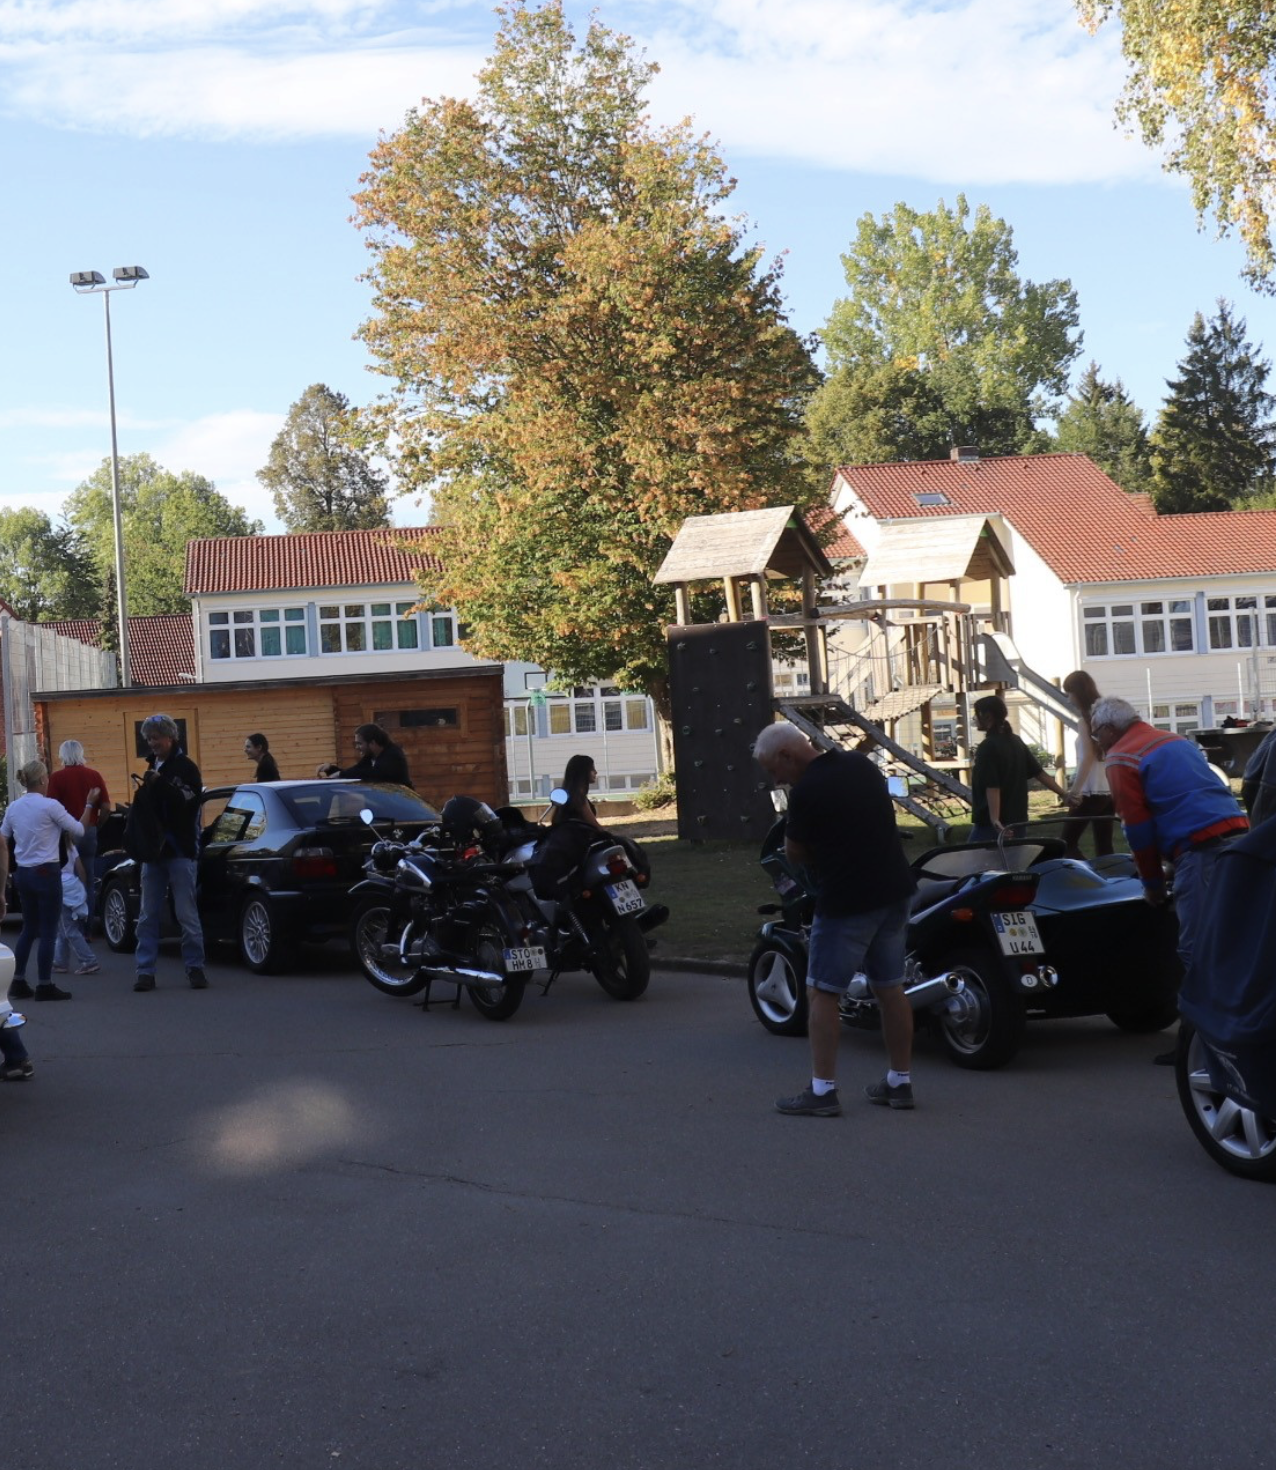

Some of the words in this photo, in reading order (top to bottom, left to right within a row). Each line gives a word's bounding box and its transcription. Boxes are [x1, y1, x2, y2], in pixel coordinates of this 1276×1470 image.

[615, 882, 629, 892] KN
[1002, 913, 1026, 926] SIG
[1009, 941, 1020, 954] U
[1021, 941, 1035, 953] 44
[511, 948, 531, 960] STO
